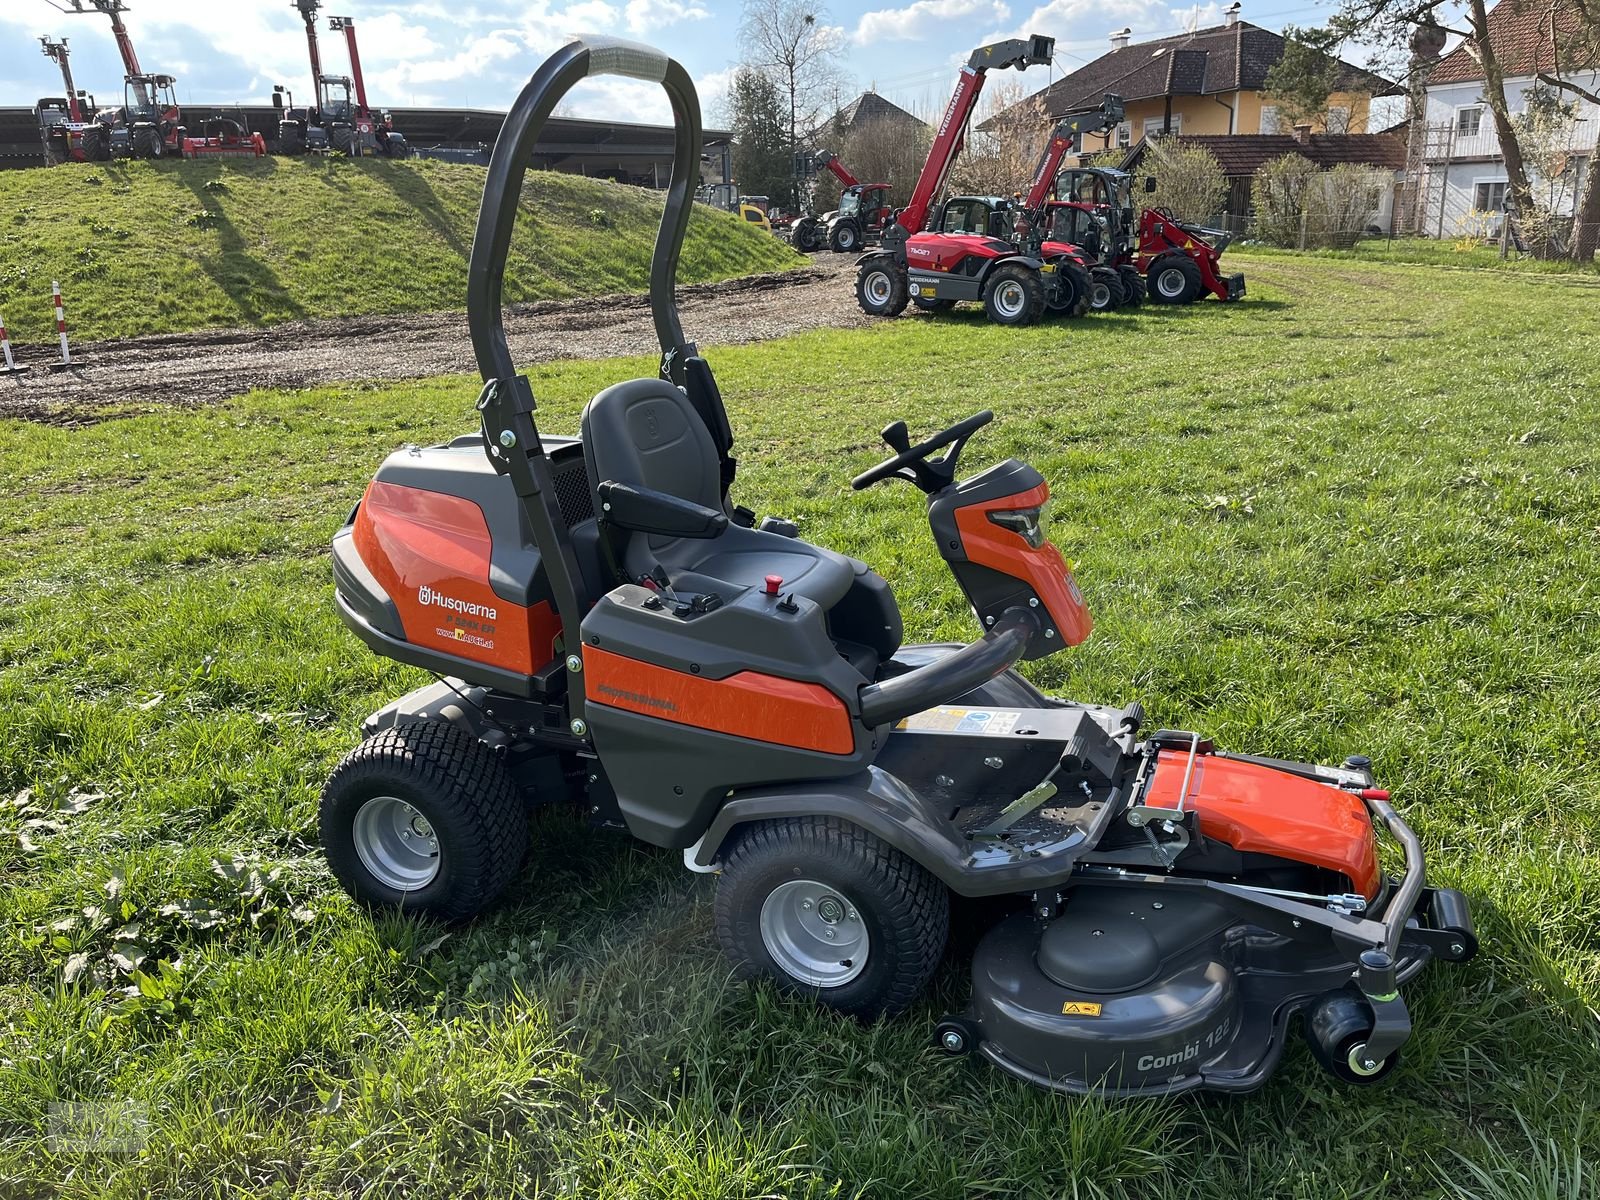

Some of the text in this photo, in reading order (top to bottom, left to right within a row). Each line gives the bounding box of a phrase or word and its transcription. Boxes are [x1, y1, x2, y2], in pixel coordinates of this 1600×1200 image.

[938, 82, 965, 137] WEIDEMANN
[431, 590, 497, 620] Husqvarna
[446, 614, 453, 623] P
[597, 684, 678, 712] PROFESSIONAL
[1137, 1016, 1230, 1071] Combi 122
